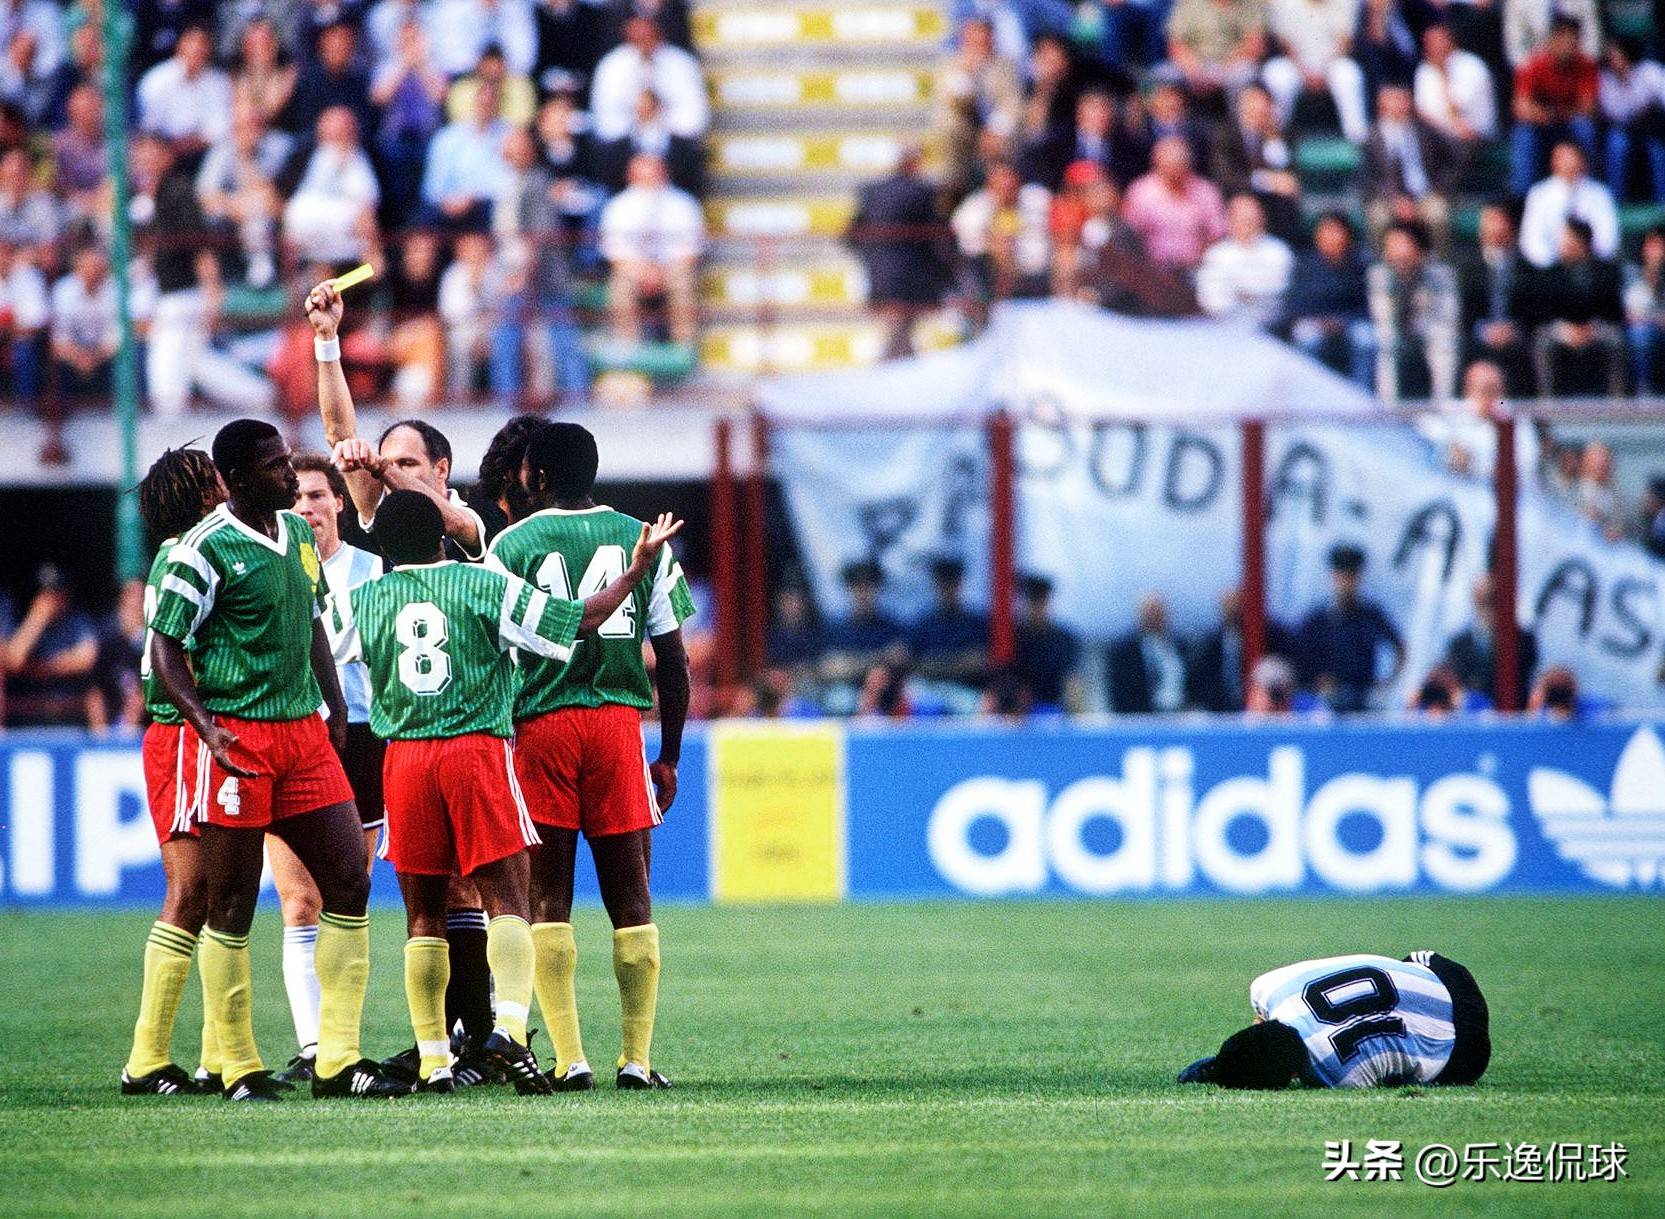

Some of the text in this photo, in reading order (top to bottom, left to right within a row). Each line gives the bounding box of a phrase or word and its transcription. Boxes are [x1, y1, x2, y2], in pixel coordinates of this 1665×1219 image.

[536, 544, 637, 642] 14
[396, 601, 452, 696] 8
[217, 776, 241, 815] 4
[927, 746, 1516, 891] adidas
[1302, 965, 1408, 1066] 10
